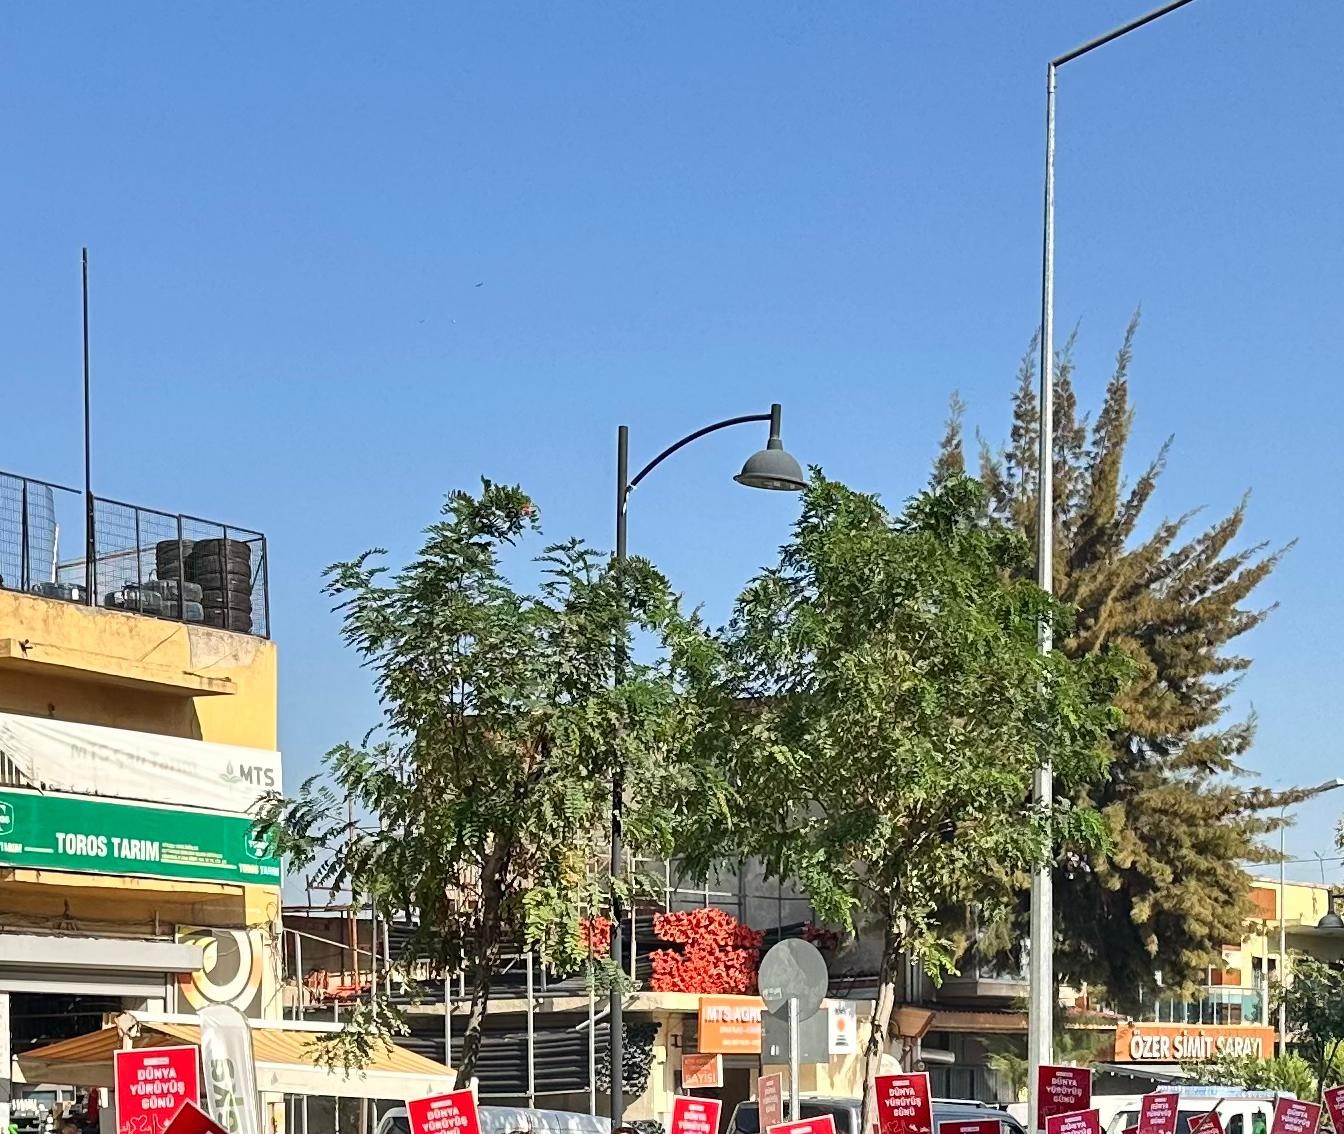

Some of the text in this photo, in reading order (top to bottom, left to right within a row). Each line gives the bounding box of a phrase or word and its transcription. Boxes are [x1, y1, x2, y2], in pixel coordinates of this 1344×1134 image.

[239, 764, 275, 787] MTS
[56, 832, 108, 857] TOROS
[111, 837, 159, 862] TARIM
[1131, 1030, 1263, 1059] ÖZER SİMİT SARAYI
[137, 1066, 177, 1081] DÜNYA
[129, 1079, 185, 1096] YÜRÜYÜŞ
[888, 1086, 916, 1097] DÜNYA
[141, 1094, 175, 1110] GÜNÜ
[884, 1096, 922, 1108] YÜRÜYÜŞ
[426, 1106, 460, 1121] DÜNYA
[893, 1106, 916, 1117] GÜNÜ
[422, 1115, 468, 1132] YÜRÜYÜŞ
